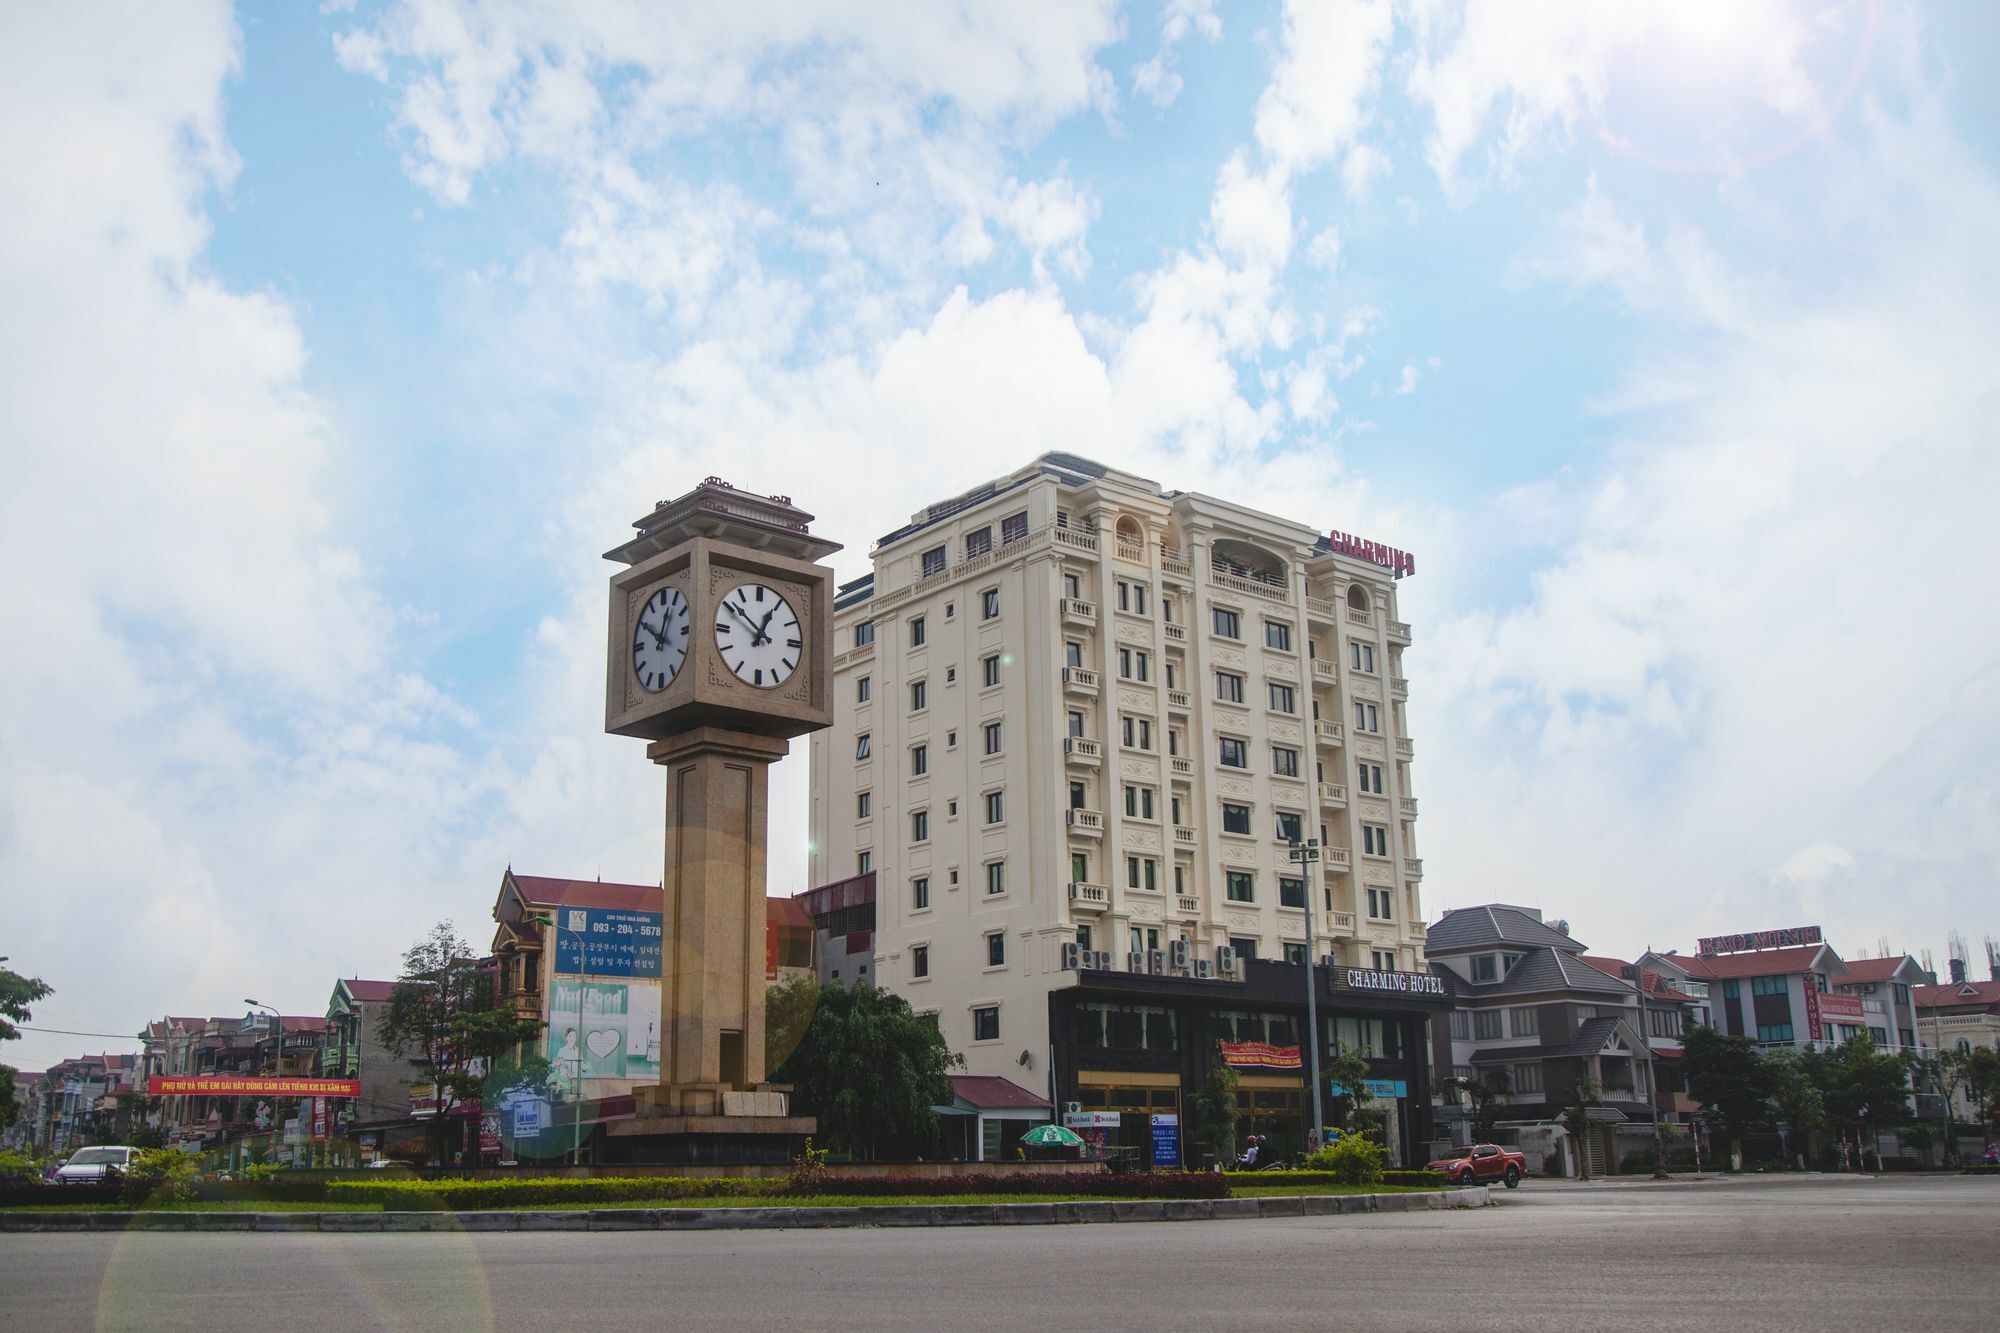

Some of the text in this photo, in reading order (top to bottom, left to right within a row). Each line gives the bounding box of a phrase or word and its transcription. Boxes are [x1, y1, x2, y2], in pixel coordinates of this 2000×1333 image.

[593, 922, 609, 933] 093
[617, 924, 633, 934] 204
[640, 926, 661, 937] 5678
[1752, 926, 1822, 949] MINH
[1347, 970, 1444, 993] CHARMING HOTEL
[162, 1081, 175, 1092] PHỤ
[187, 1081, 196, 1090] VÀ
[210, 1082, 220, 1090] EM
